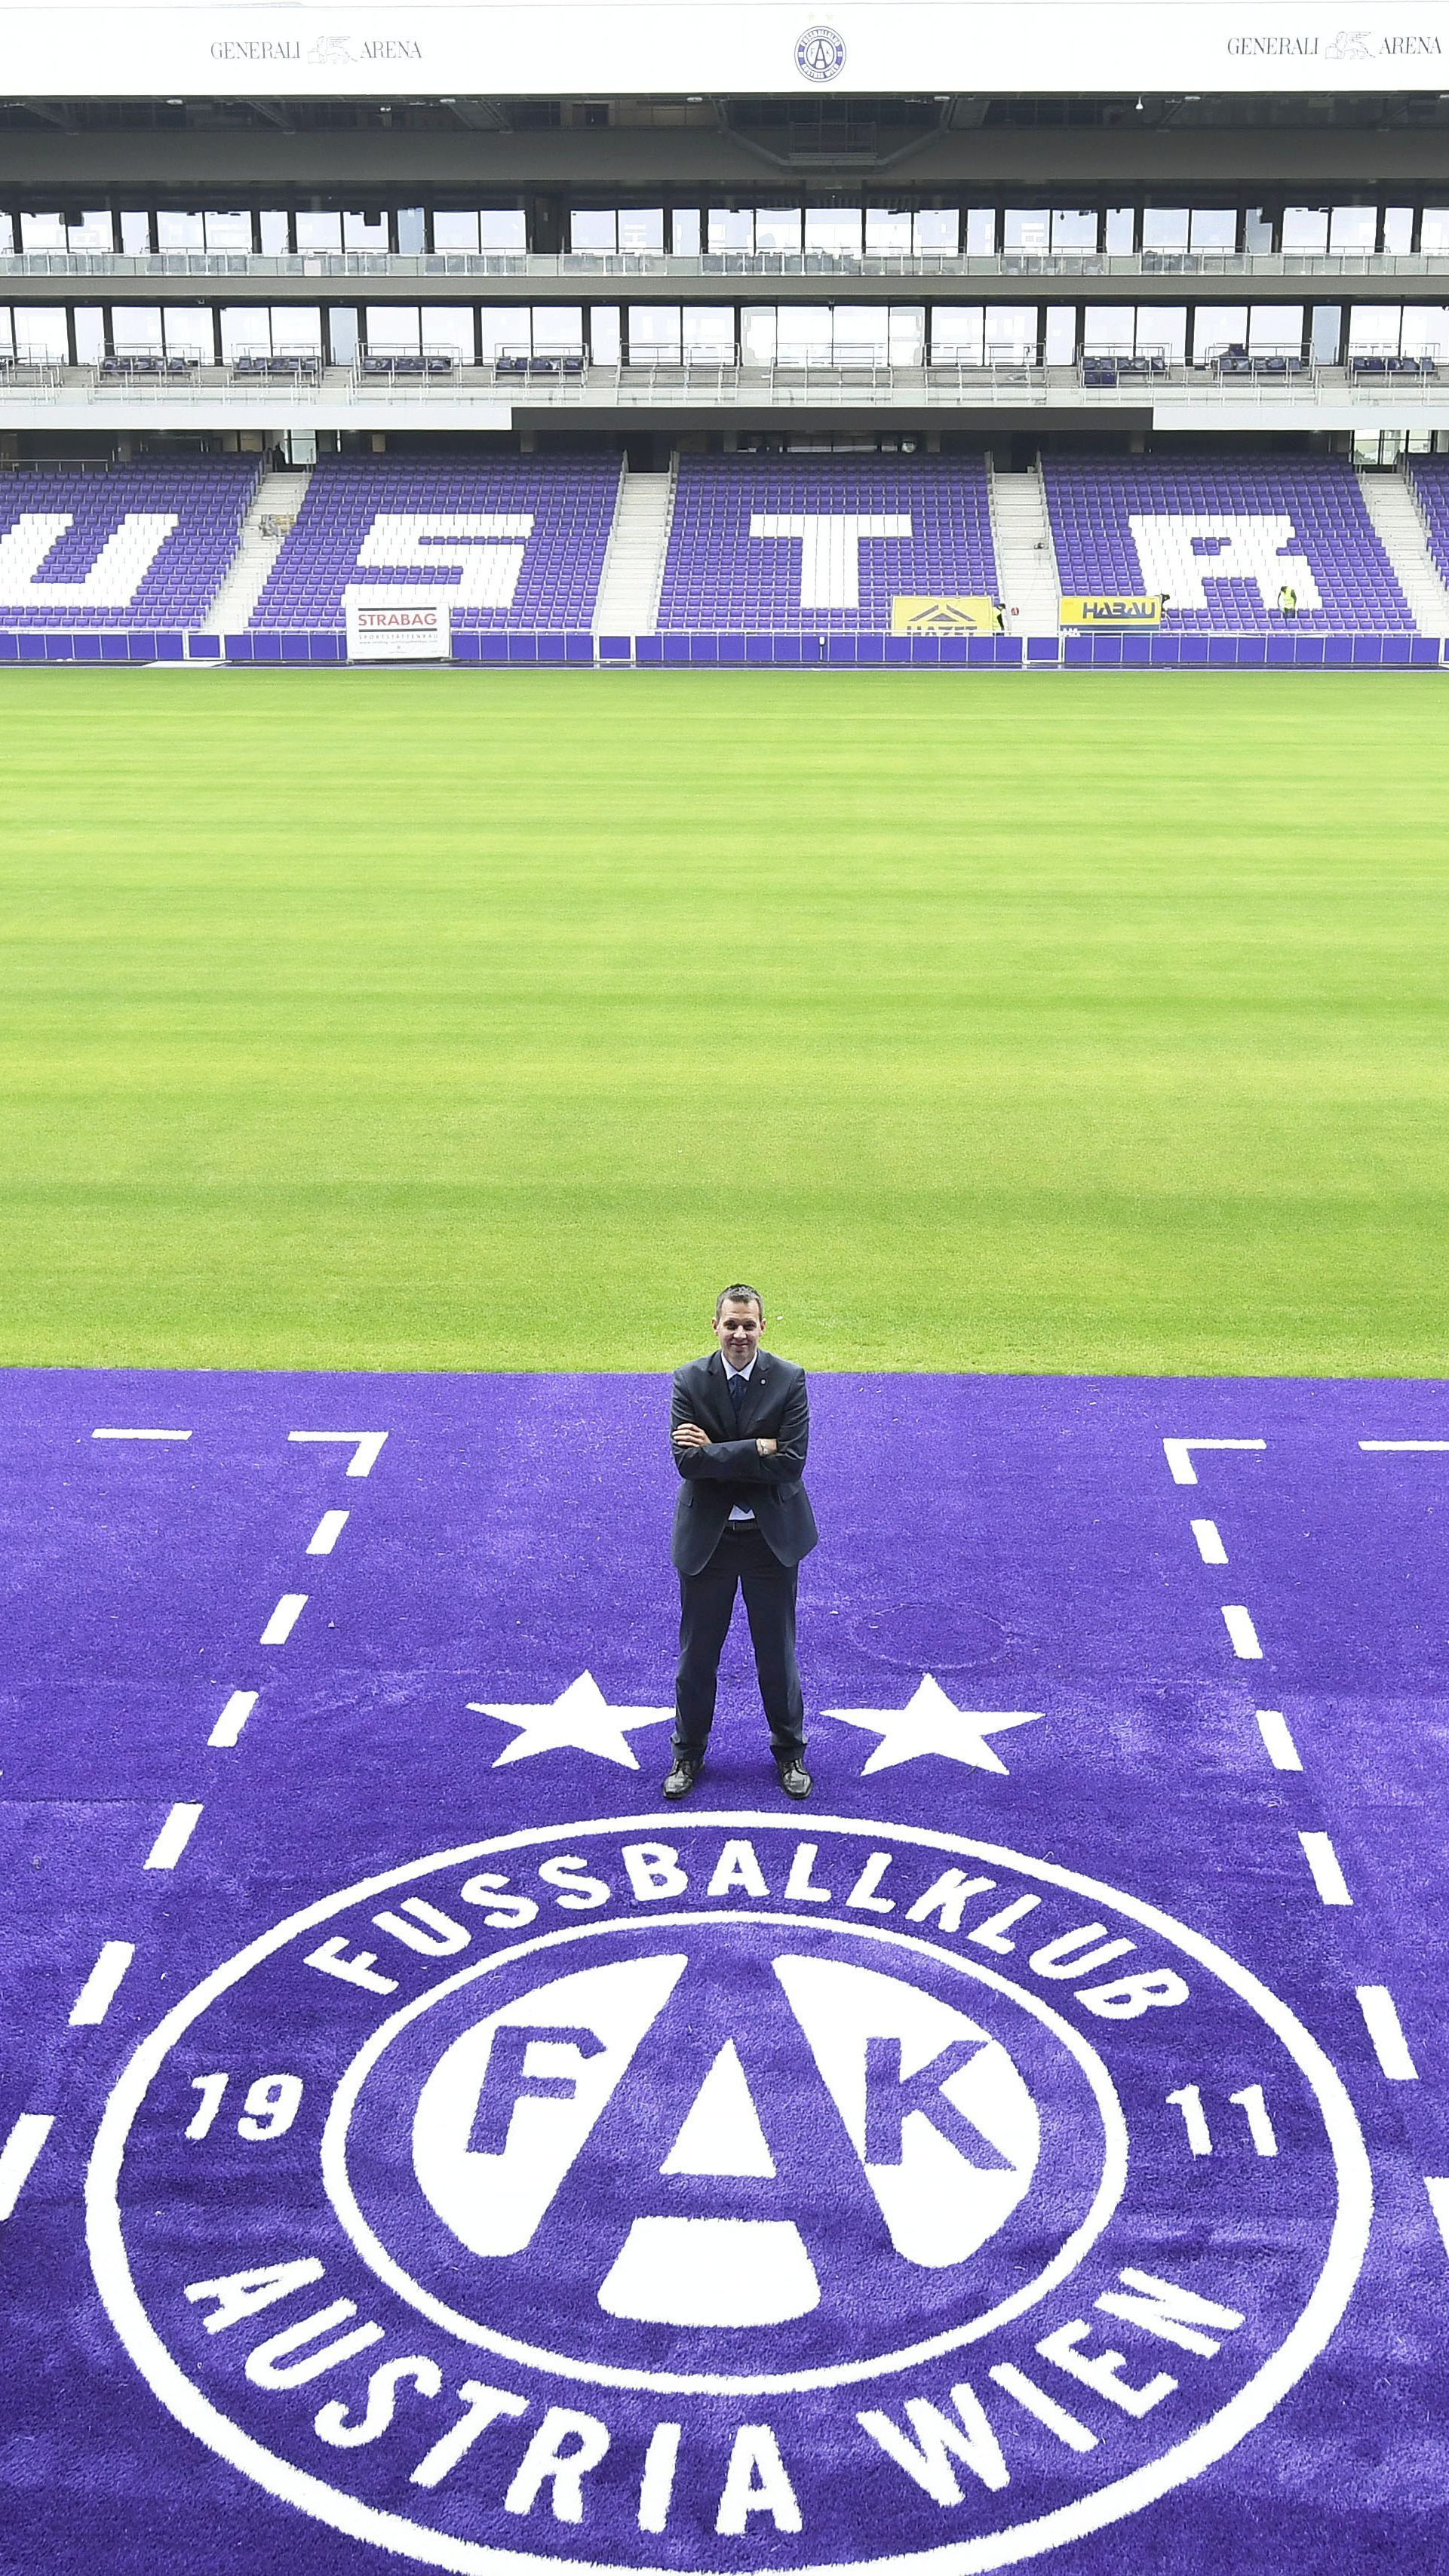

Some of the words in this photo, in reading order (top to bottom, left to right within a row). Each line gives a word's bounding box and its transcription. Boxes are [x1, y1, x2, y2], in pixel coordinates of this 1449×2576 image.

[210, 41, 301, 60] GENERALI
[360, 41, 422, 59] ARENA
[1227, 37, 1319, 55] GENERALI
[1379, 36, 1442, 55] ARENA
[358, 613, 437, 626] STRABAG
[1082, 602, 1156, 619] HABAU
[303, 1840, 1190, 2019] FUSSBALLKLUB
[184, 2072, 304, 2142] 19
[1165, 2083, 1278, 2157] 11
[184, 2256, 803, 2535] AUSTRIA
[856, 2266, 1246, 2509] WIEN
